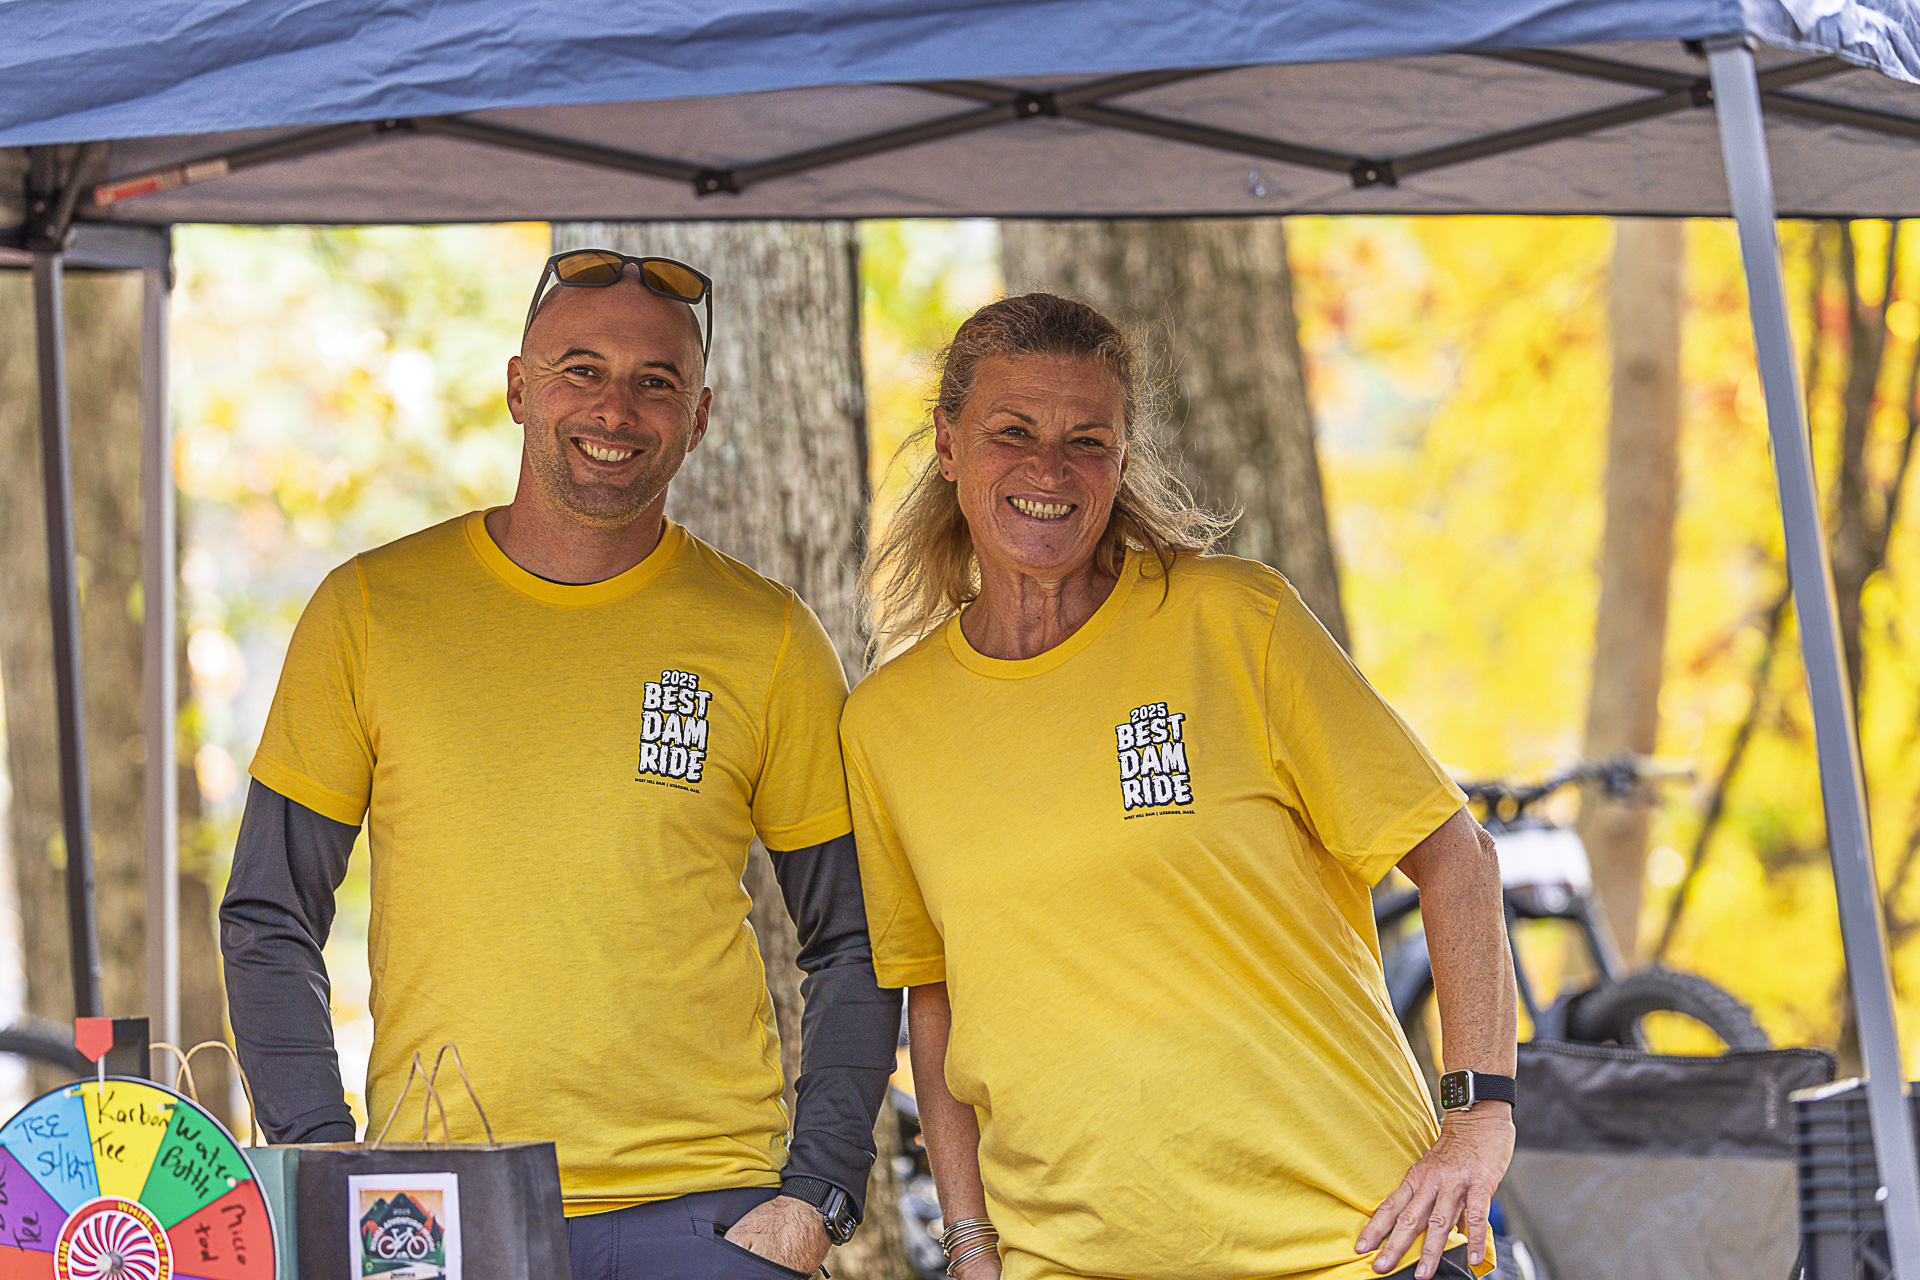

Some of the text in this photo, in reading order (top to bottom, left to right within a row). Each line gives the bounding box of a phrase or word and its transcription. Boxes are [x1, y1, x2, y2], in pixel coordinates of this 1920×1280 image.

[661, 669, 699, 690] 2025
[643, 682, 713, 719] BEST
[1130, 702, 1167, 723] 2025
[640, 710, 709, 751] DAM
[1115, 712, 1186, 753] BEST
[639, 742, 707, 783] RIDE
[1118, 741, 1189, 781] DAM
[1121, 774, 1194, 811] RIDE
[97, 1090, 169, 1128] Karbon
[91, 1131, 125, 1163] Tee
[117, 1201, 154, 1231] WHIRL
[153, 1232, 167, 1250] OF
[221, 1204, 246, 1265] Micro
[58, 1240, 69, 1272] FUN
